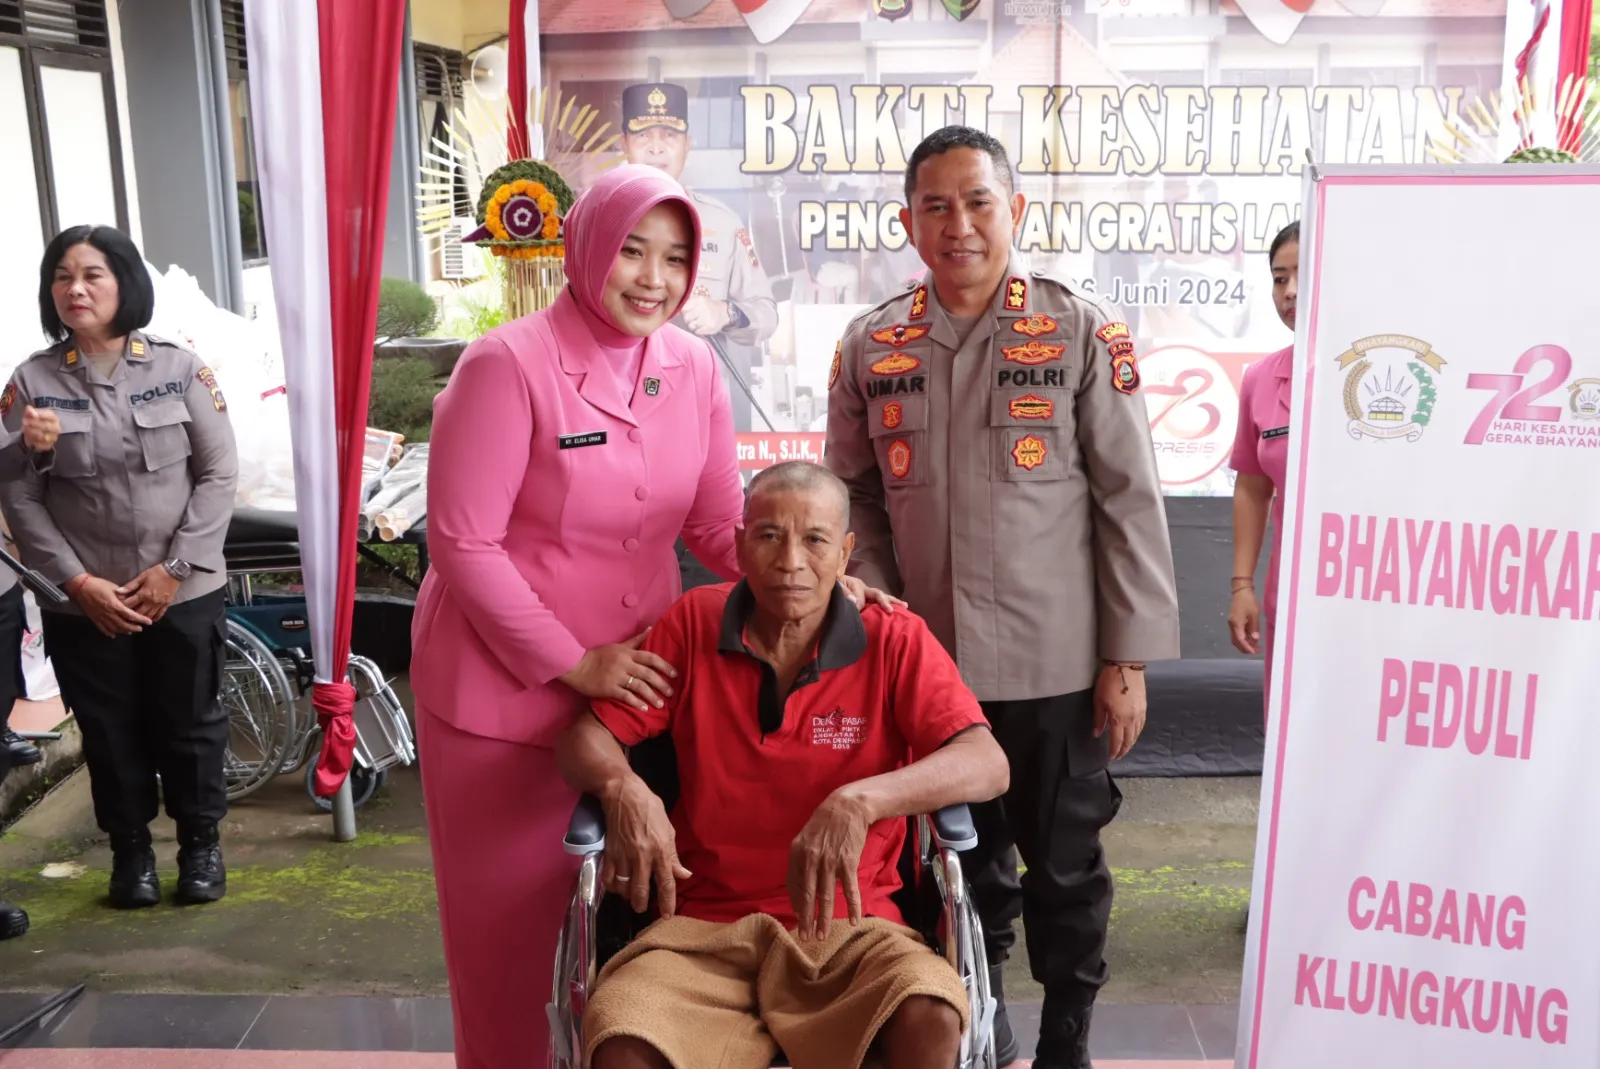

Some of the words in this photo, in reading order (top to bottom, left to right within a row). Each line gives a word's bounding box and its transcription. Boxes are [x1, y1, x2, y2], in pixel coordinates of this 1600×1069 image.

[740, 84, 993, 175] BAKTI
[1017, 84, 1465, 175] KESEHATAN
[799, 200, 1083, 254] PENGAN
[1088, 202, 1237, 255] GRATIS
[1243, 203, 1300, 254] LA
[1106, 278, 1168, 304] Juni
[1178, 278, 1246, 305] 2024
[867, 375, 926, 399] UMAR
[997, 368, 1065, 388] POLRI
[131, 381, 184, 406] POLRI
[1485, 433, 1533, 445] GERAK
[1536, 435, 1600, 449] BHAYAN
[1493, 421, 1527, 433] HARI
[1531, 424, 1600, 438] KESATUA
[736, 441, 755, 460] tra
[1377, 657, 1538, 760] PEDULI
[1347, 876, 1526, 950] CABANG
[1294, 953, 1569, 1045] KLUNGKUNG
